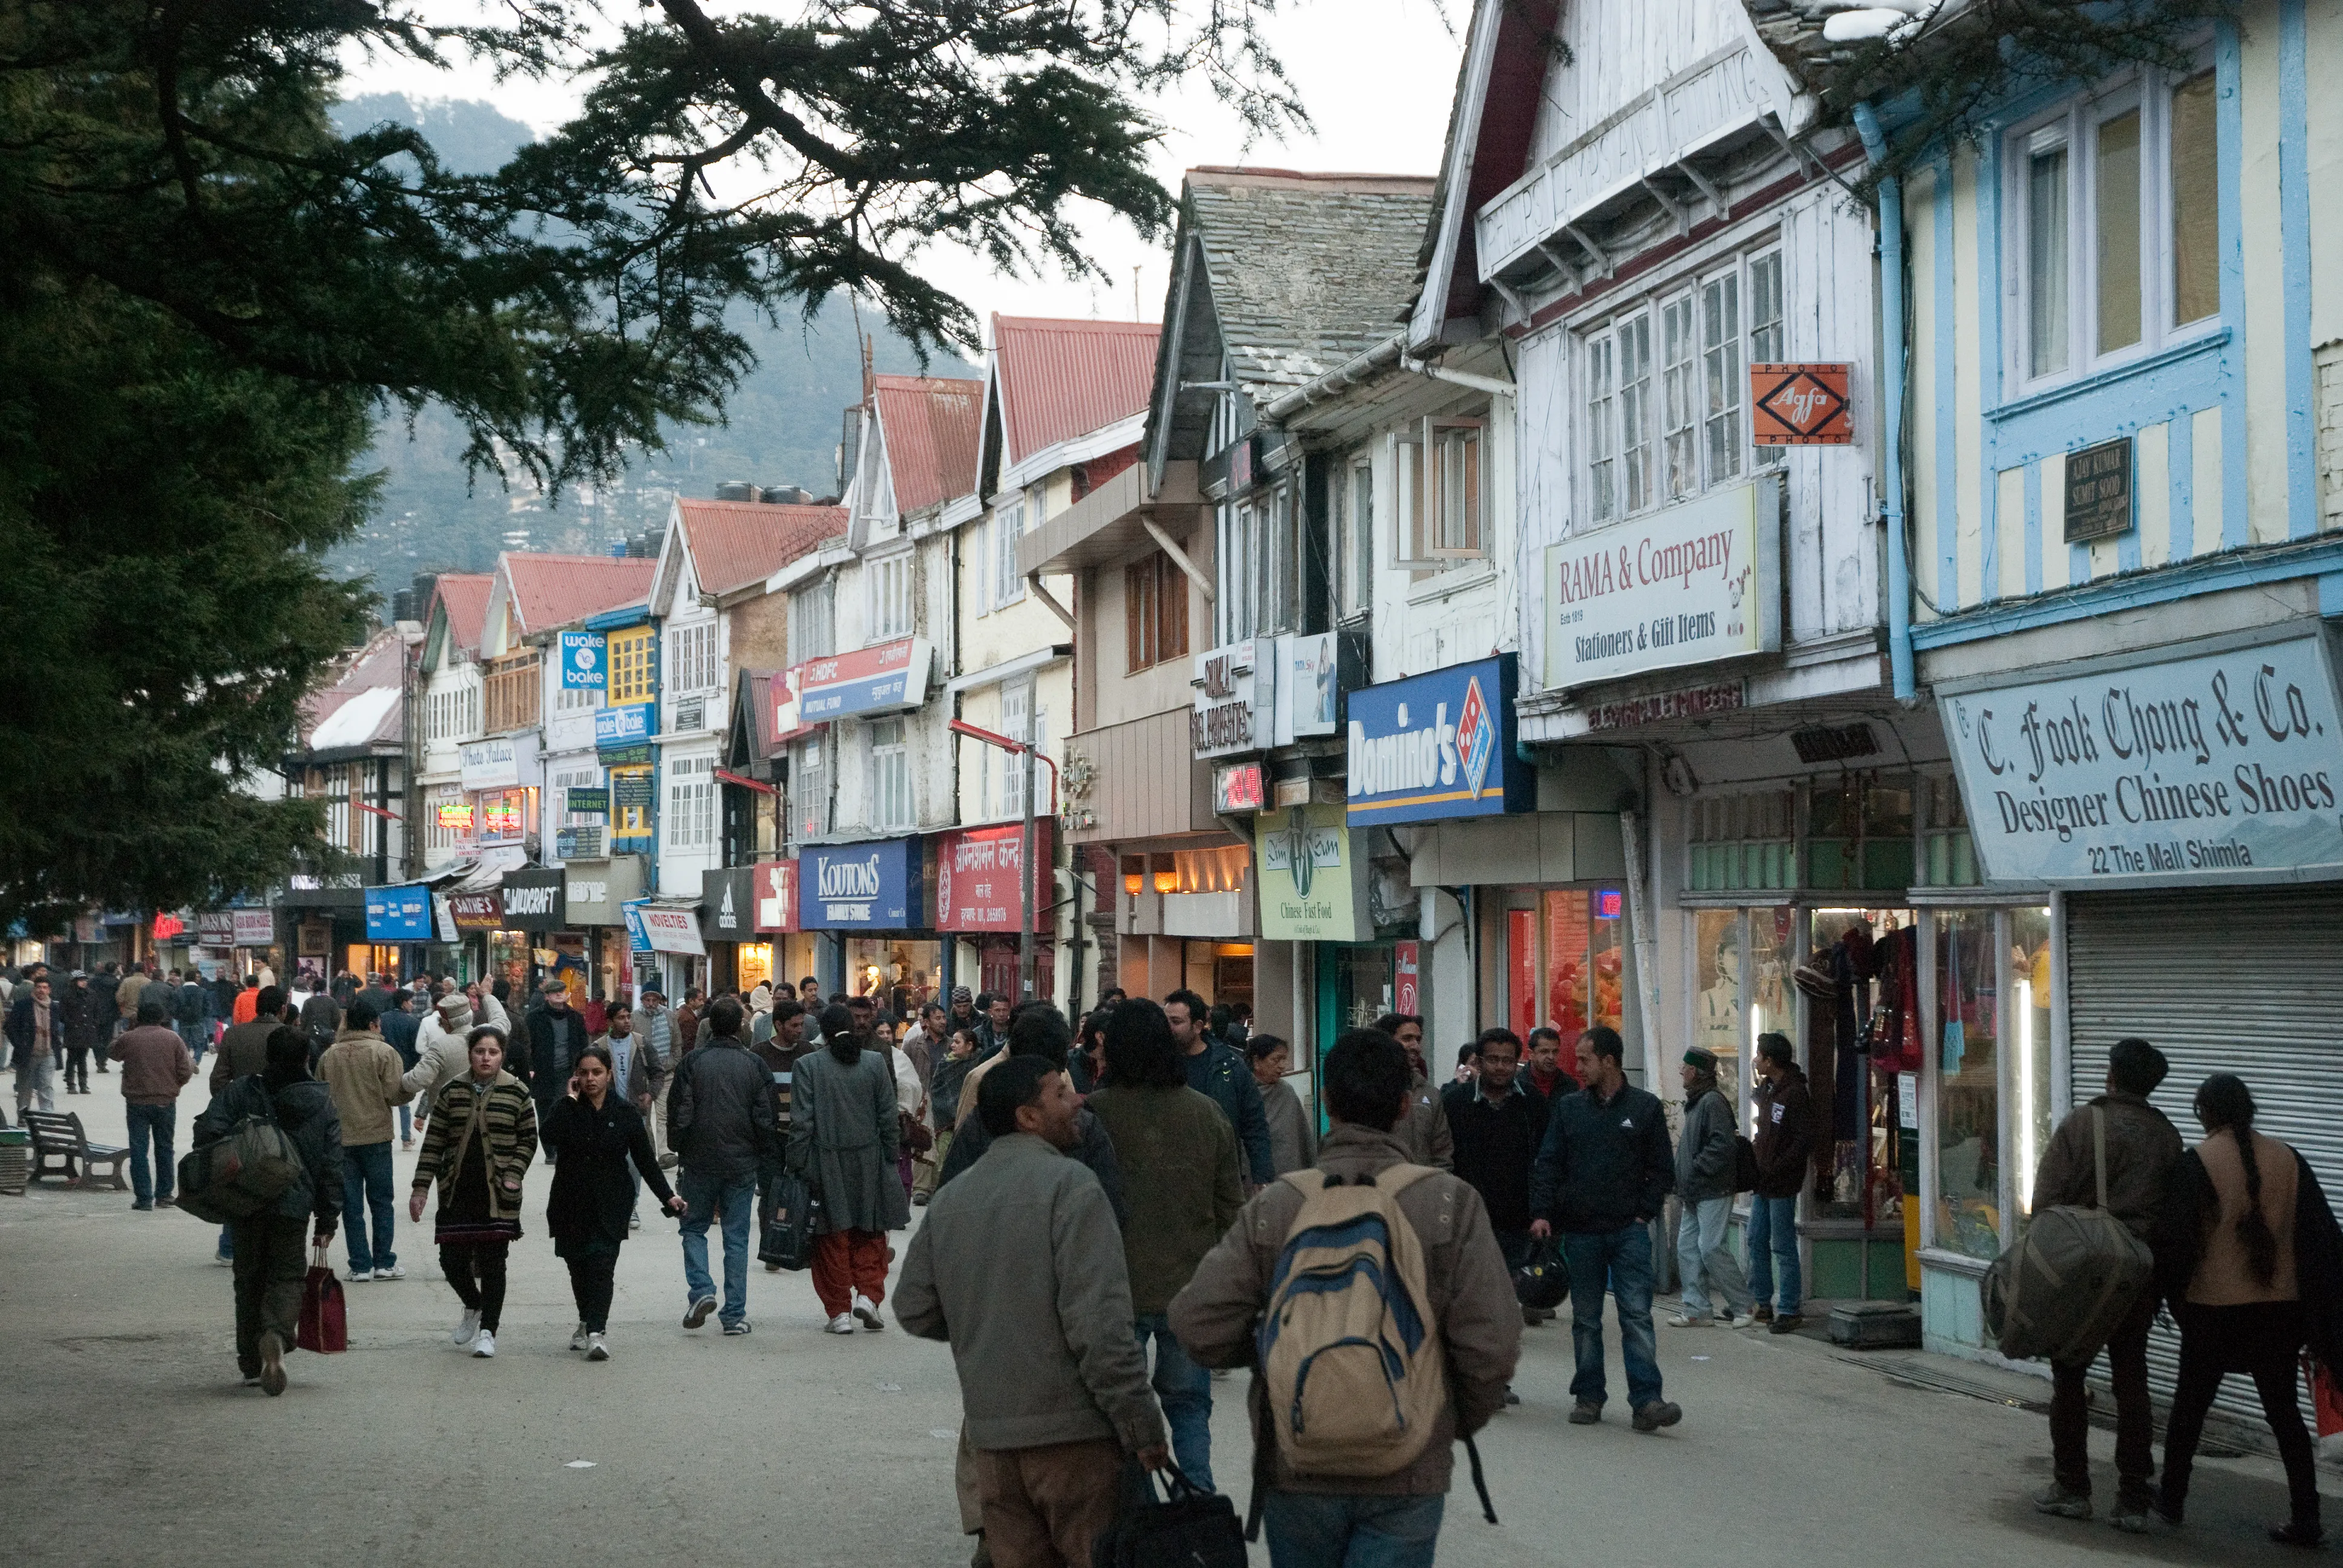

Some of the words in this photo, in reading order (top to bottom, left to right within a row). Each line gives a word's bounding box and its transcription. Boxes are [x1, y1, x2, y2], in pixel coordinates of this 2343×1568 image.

[1765, 364, 1837, 373] PHOTO
[1772, 387, 1827, 424] Agfa
[1770, 435, 1841, 444] PHOTO
[1560, 550, 1614, 605] RAMA
[1619, 545, 1633, 590] &
[1637, 529, 1734, 590] Company
[565, 634, 605, 648] wake
[1576, 629, 1633, 663] Stationers
[1637, 622, 1647, 651] &
[1651, 616, 1674, 648] Gift
[1678, 610, 1715, 643] Items
[566, 668, 604, 684] bake
[815, 661, 838, 682] HDFC
[1205, 654, 1235, 697] SHIMLA
[805, 699, 826, 714] MUTUAL
[827, 696, 841, 710] FUND
[597, 719, 614, 734] wake
[625, 714, 643, 730] bake
[1978, 708, 2015, 776] C.
[2102, 687, 2210, 771] Chong
[2211, 668, 2249, 746] &
[2253, 663, 2324, 742] Co.
[462, 746, 484, 768] Photo
[486, 743, 513, 765] Palace
[1348, 702, 1457, 797] Domino's
[569, 800, 606, 809] INTERNET
[1994, 786, 2109, 843] Designer
[2115, 772, 2232, 823] Chinese
[2233, 763, 2335, 814] Shoes
[1314, 833, 1339, 857] Sum
[2086, 846, 2109, 874] 22
[2109, 844, 2145, 873] The
[2146, 841, 2185, 871] Mall
[2186, 838, 2253, 869] Shimla
[818, 854, 880, 897] KOUTONS
[455, 897, 493, 913] SATHE'S
[511, 886, 557, 915] WILDCRAFT
[1280, 901, 1302, 919] Chinese
[1304, 901, 1316, 919] Fast
[1318, 901, 1332, 919] Food
[649, 913, 688, 930] NOVELTIES
[719, 913, 737, 929] adidas
[850, 904, 871, 921] STORE
